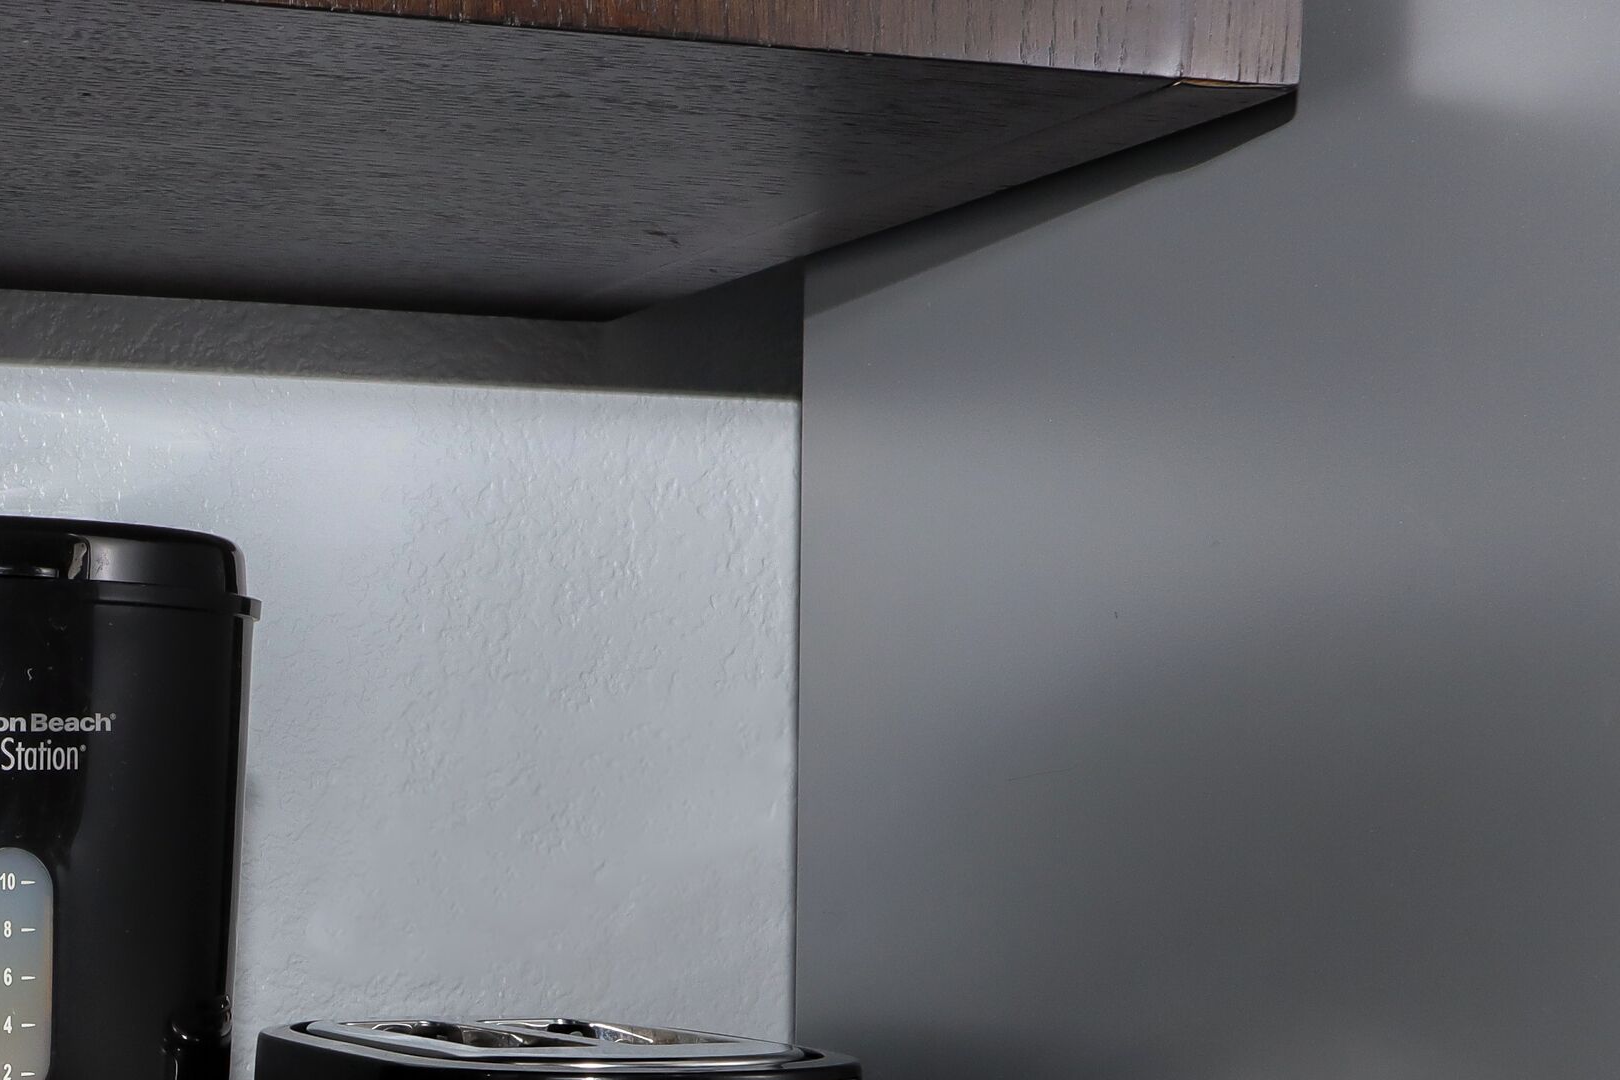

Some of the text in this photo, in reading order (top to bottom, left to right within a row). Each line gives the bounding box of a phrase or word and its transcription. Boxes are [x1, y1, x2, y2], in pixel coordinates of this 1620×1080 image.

[0, 873, 16, 890] 10
[3, 920, 12, 938] 8
[3, 968, 12, 986] 6
[3, 1016, 13, 1034] 4
